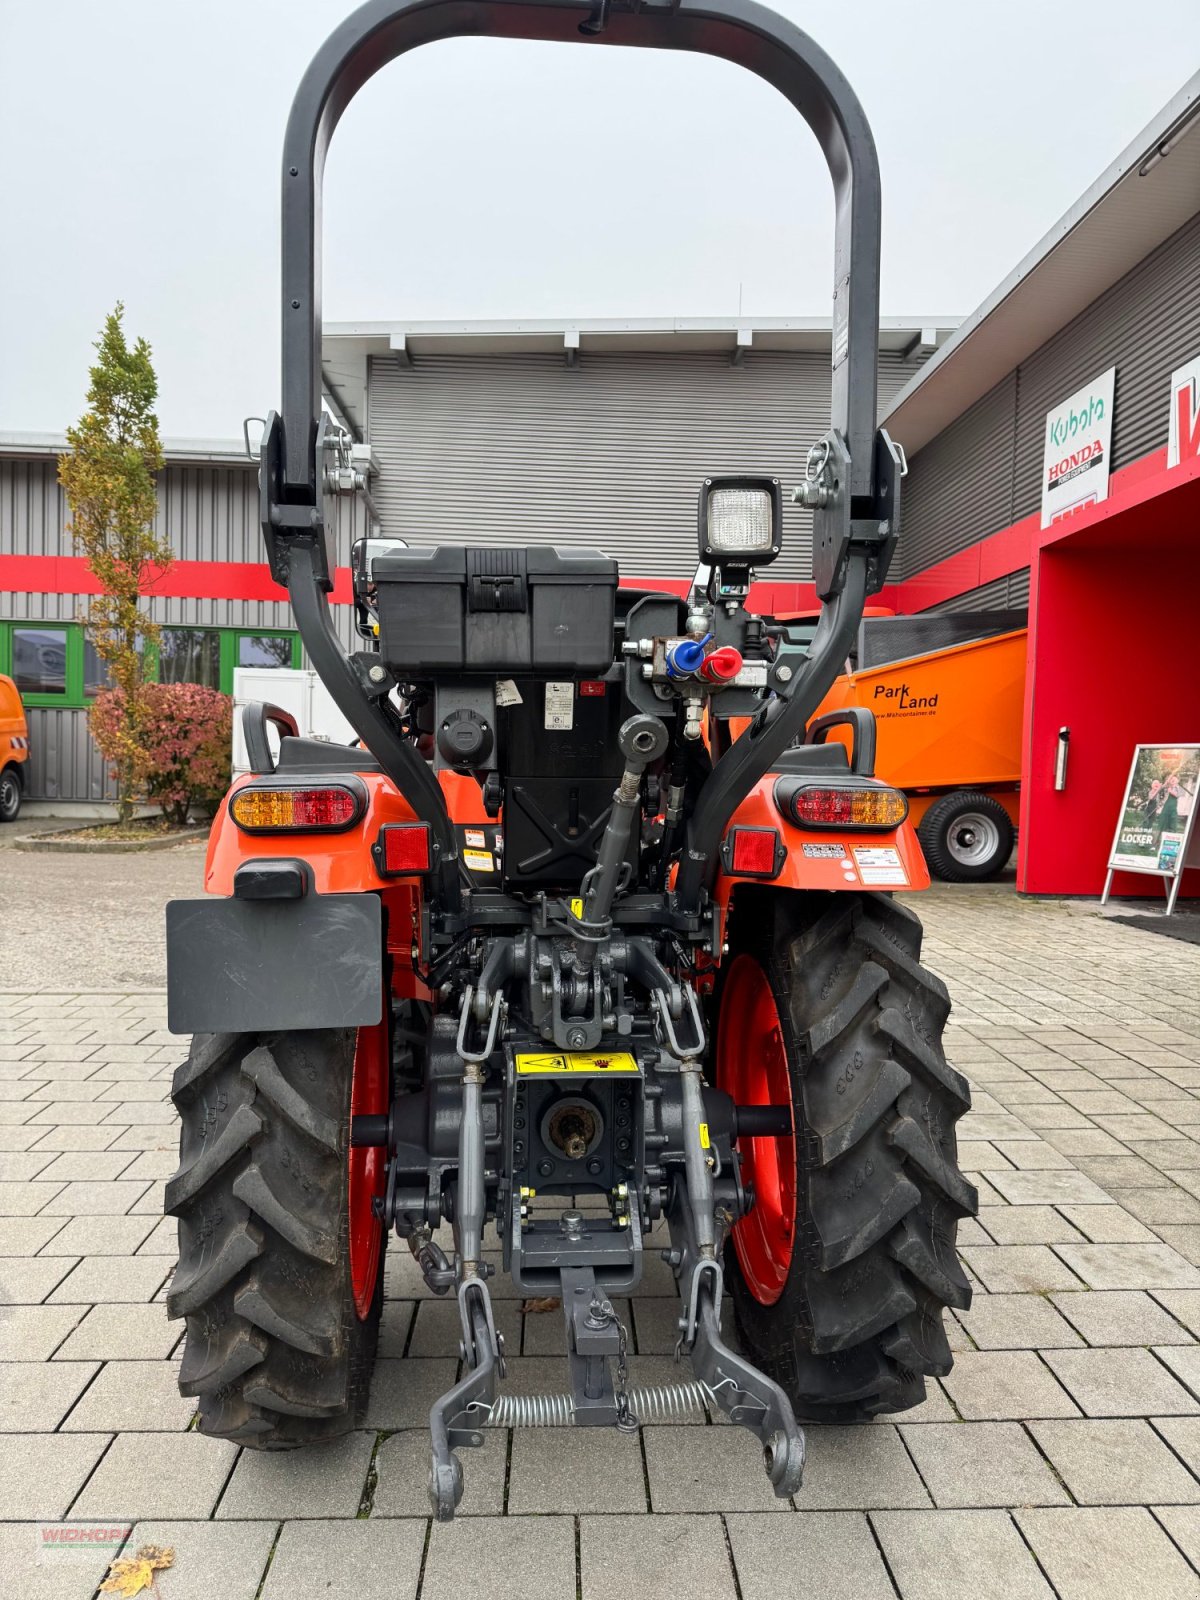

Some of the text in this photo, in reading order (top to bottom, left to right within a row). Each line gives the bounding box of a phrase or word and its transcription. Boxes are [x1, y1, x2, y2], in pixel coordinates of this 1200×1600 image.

[1050, 396, 1105, 446] Kubota
[1048, 440, 1104, 481] HONDA
[874, 683, 910, 699] Park
[899, 694, 938, 709] Land
[1121, 834, 1153, 845] LOCKER
